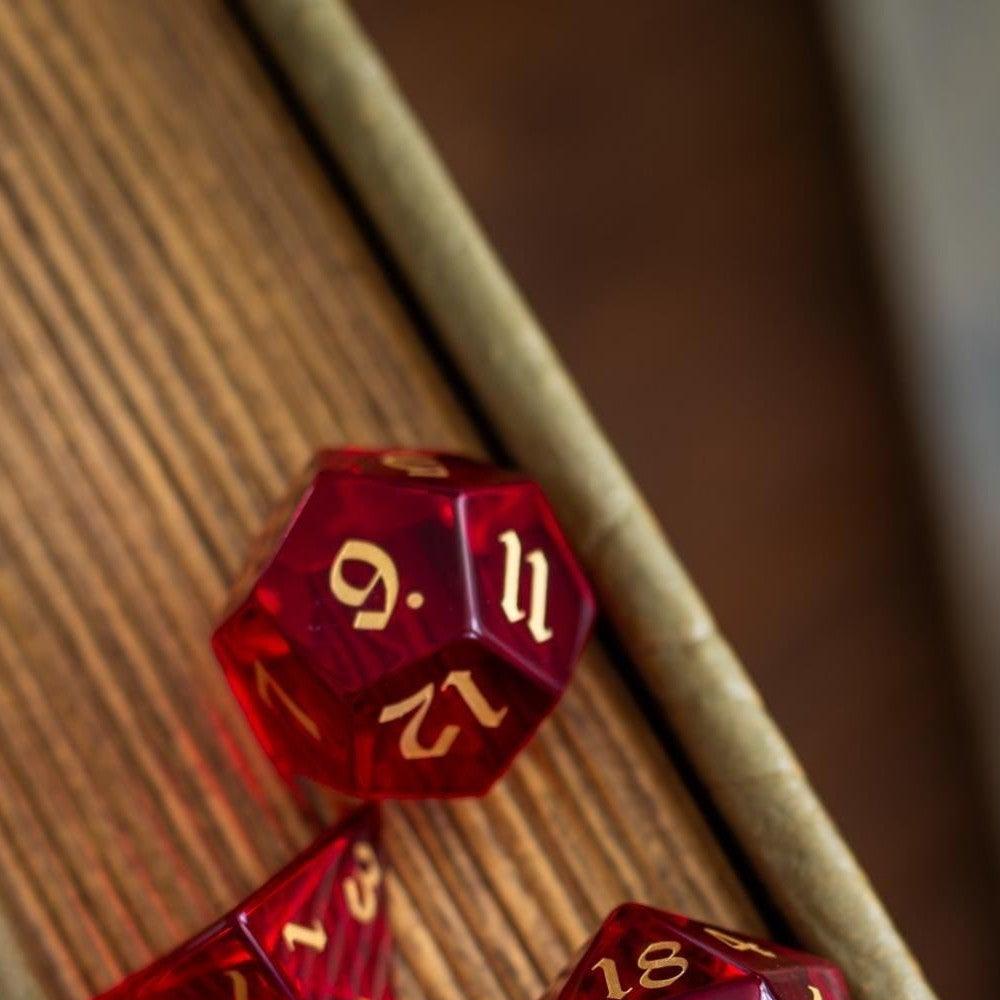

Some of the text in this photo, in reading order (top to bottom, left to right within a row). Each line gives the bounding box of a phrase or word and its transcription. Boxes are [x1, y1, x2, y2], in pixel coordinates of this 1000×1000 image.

[498, 529, 554, 644] 11
[378, 670, 508, 760] 12
[591, 940, 689, 1000] 18
[703, 928, 777, 958] 4
